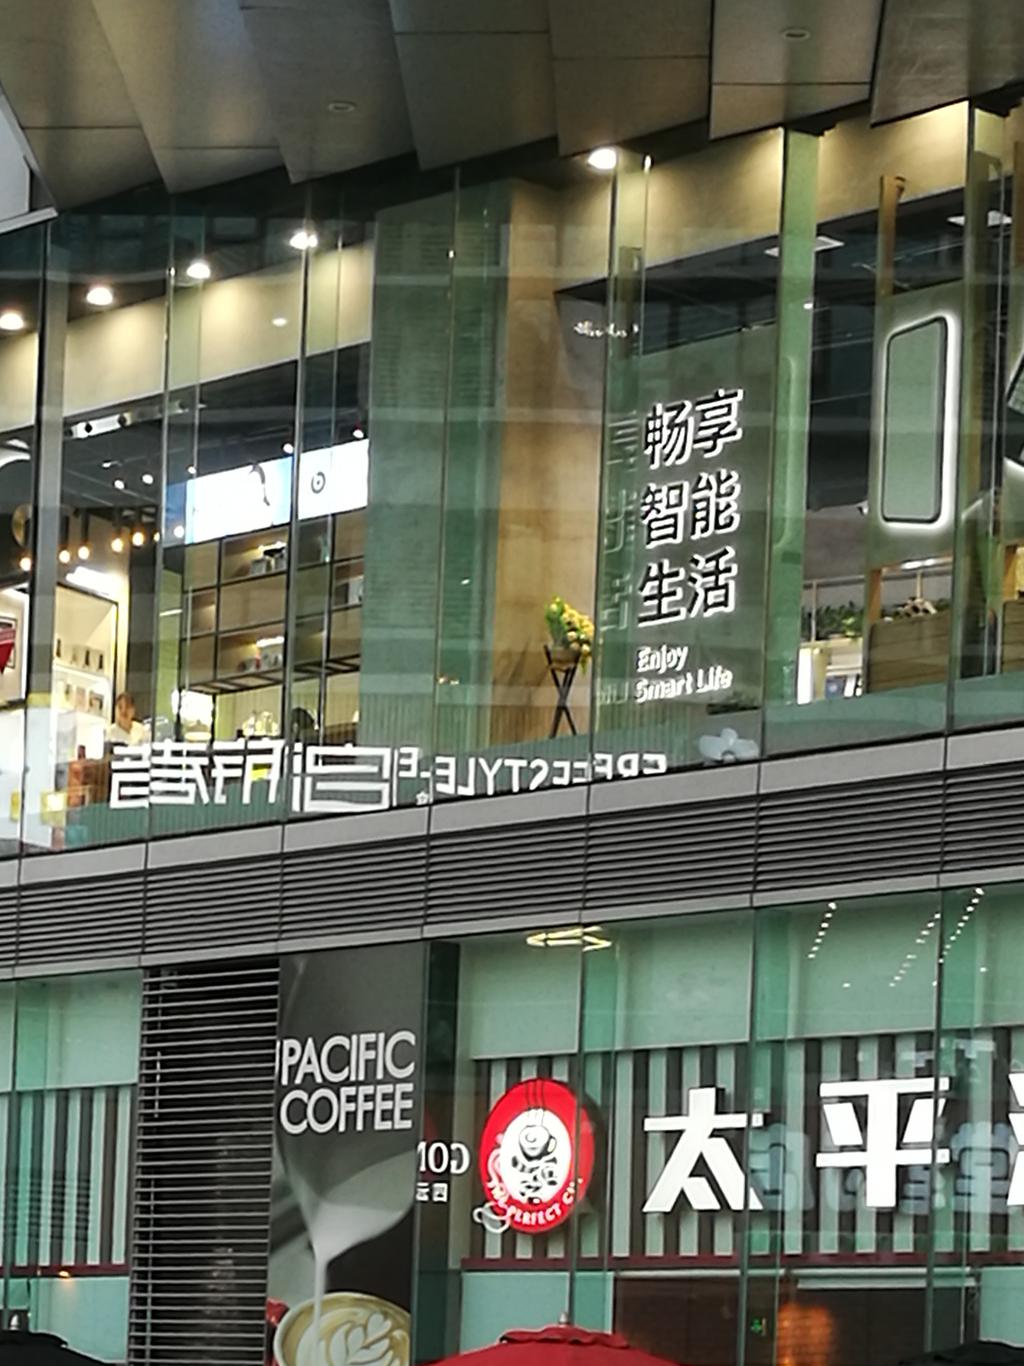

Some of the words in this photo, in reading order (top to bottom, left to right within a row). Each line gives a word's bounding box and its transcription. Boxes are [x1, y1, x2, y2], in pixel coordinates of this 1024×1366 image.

[643, 387, 744, 470] 畅享
[639, 468, 741, 550] 智能
[636, 546, 738, 628] 生活
[634, 671, 694, 704] Smart
[696, 665, 734, 692] Life
[635, 645, 689, 674] Enjoy
[280, 1030, 416, 1086] PACIFIC
[280, 1082, 414, 1135] COFFEE
[507, 1202, 562, 1226] PERFECT
